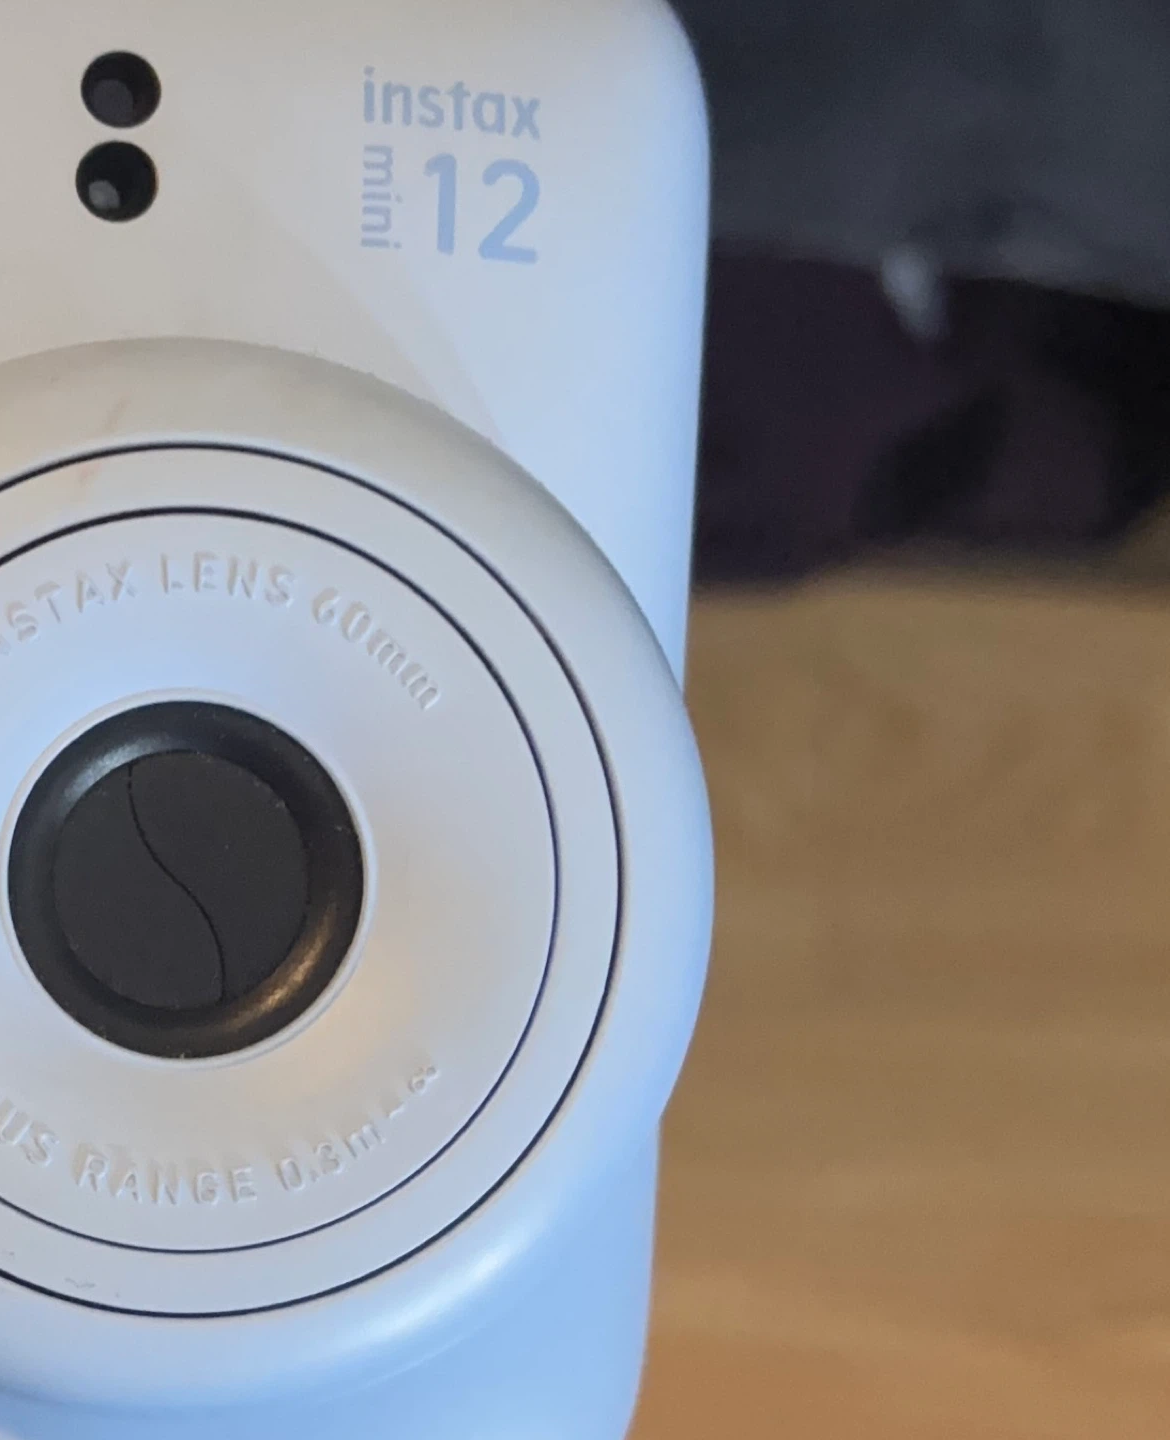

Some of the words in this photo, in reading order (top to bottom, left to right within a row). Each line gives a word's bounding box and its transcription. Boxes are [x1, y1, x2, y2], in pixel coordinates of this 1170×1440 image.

[362, 64, 542, 140] instax
[360, 144, 403, 250] mini
[422, 151, 541, 264] 12
[158, 551, 297, 609] LENS
[310, 586, 442, 711] 60mm
[71, 1142, 259, 1206] RANGE
